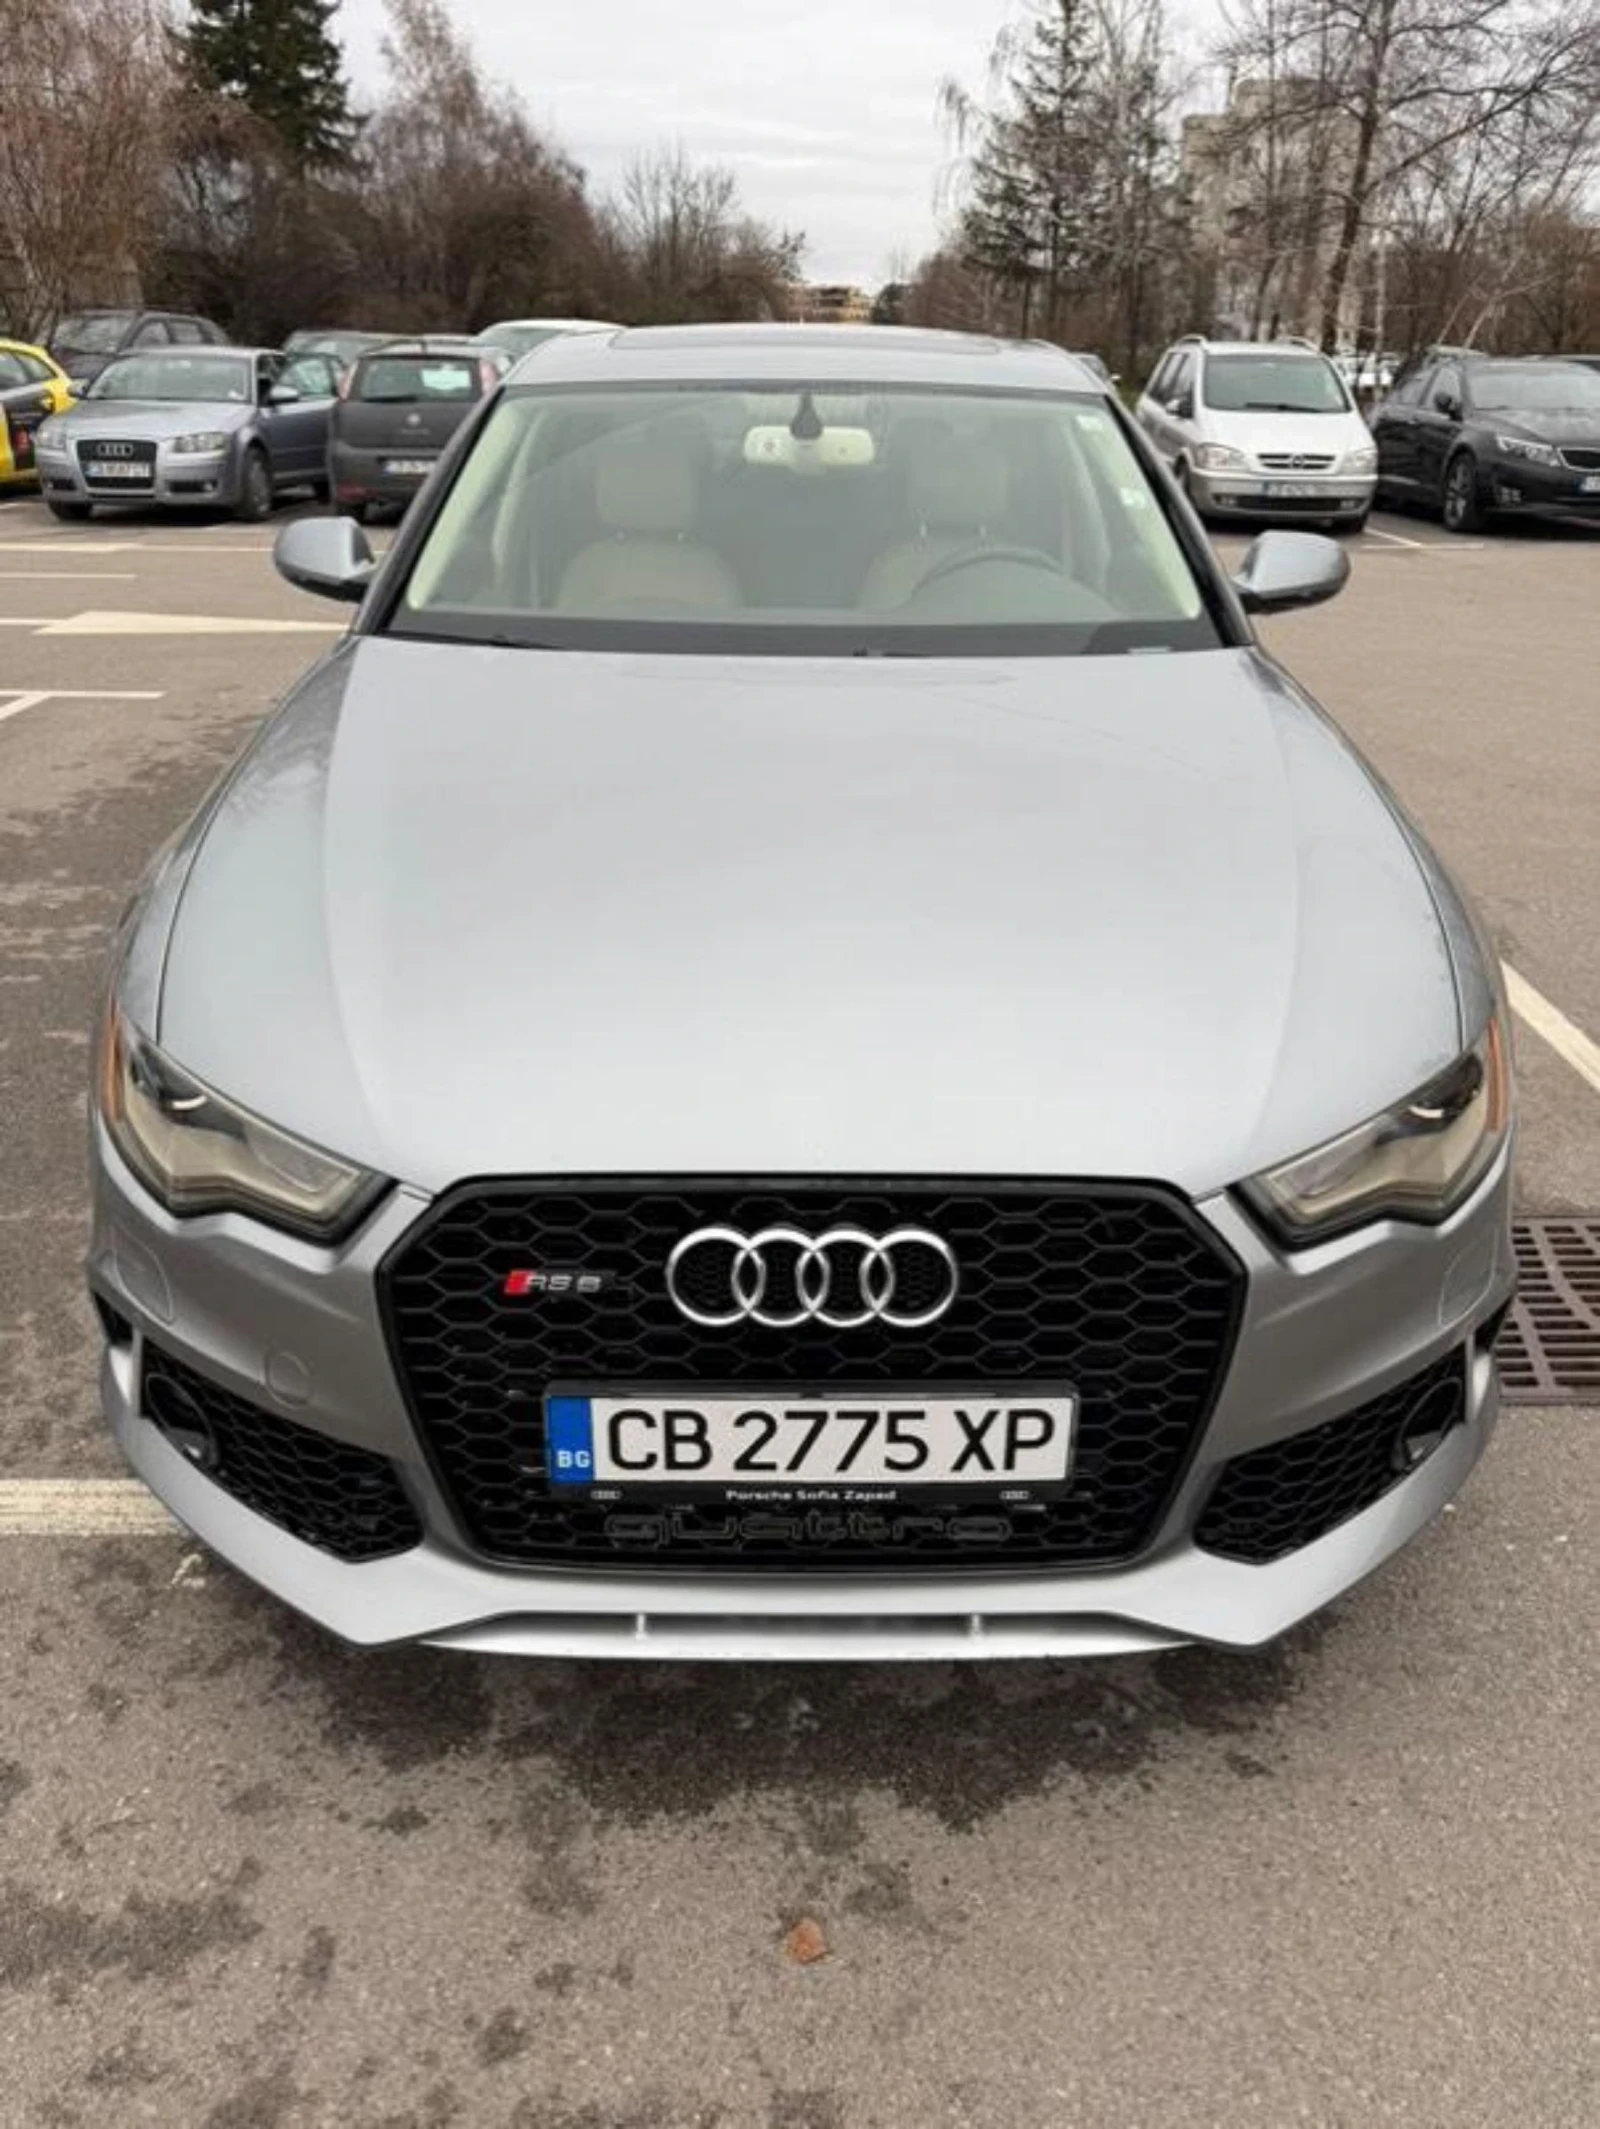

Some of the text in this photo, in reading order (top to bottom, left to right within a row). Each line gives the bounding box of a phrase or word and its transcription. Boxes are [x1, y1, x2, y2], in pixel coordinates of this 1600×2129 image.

[608, 1408, 1055, 1473] CB 2775 XP
[557, 1451, 591, 1468] BG
[725, 1489, 792, 1500] Porsche
[797, 1489, 838, 1500] Sofia
